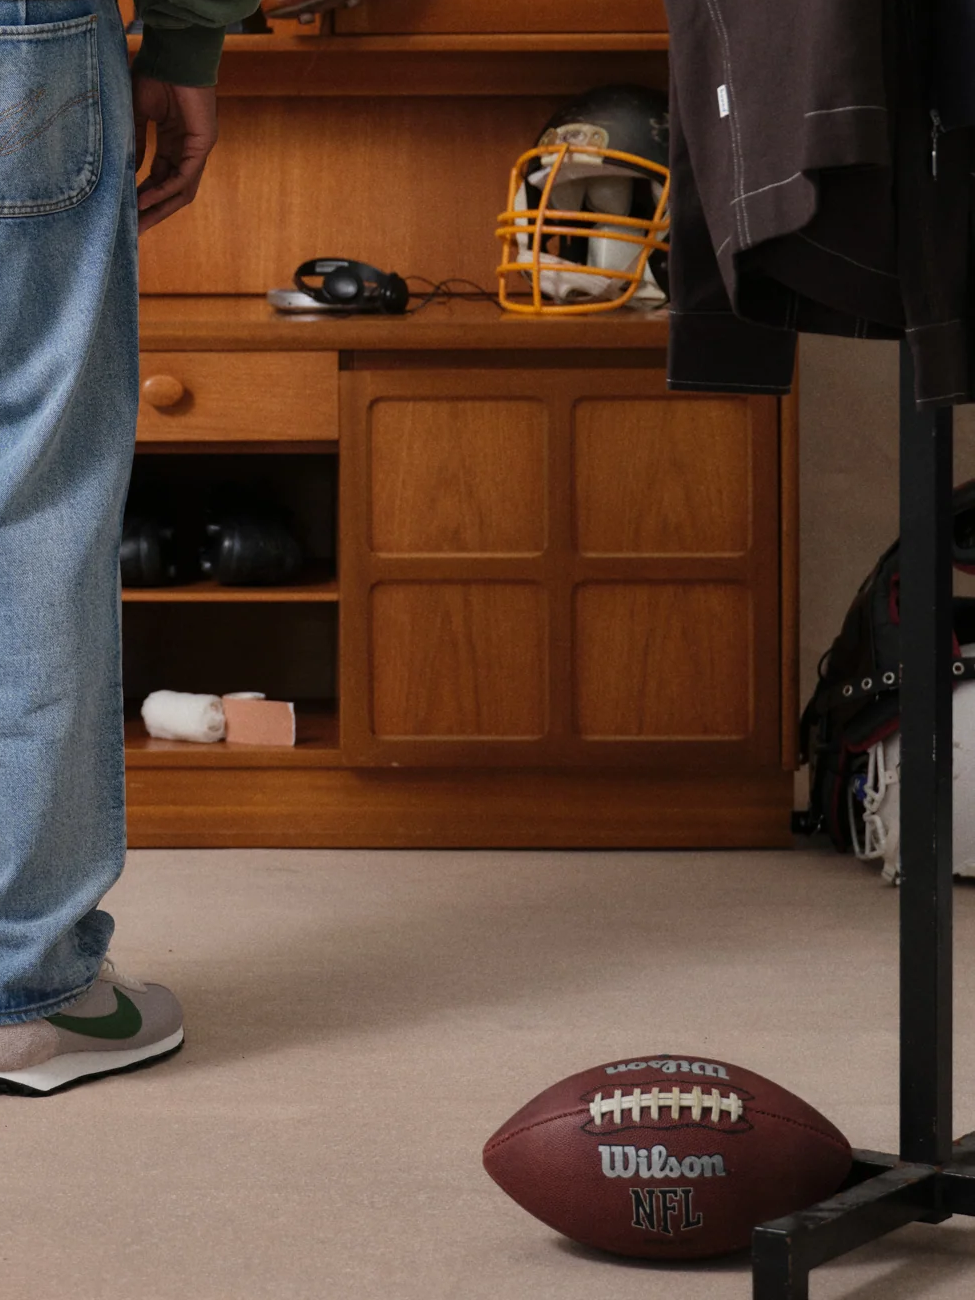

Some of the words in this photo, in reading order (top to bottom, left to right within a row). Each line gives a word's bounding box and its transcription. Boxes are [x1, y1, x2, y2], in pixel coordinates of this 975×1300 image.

[605, 1059, 730, 1080] Wilson
[597, 1144, 728, 1179] Wilson
[630, 1186, 704, 1236] NFL
